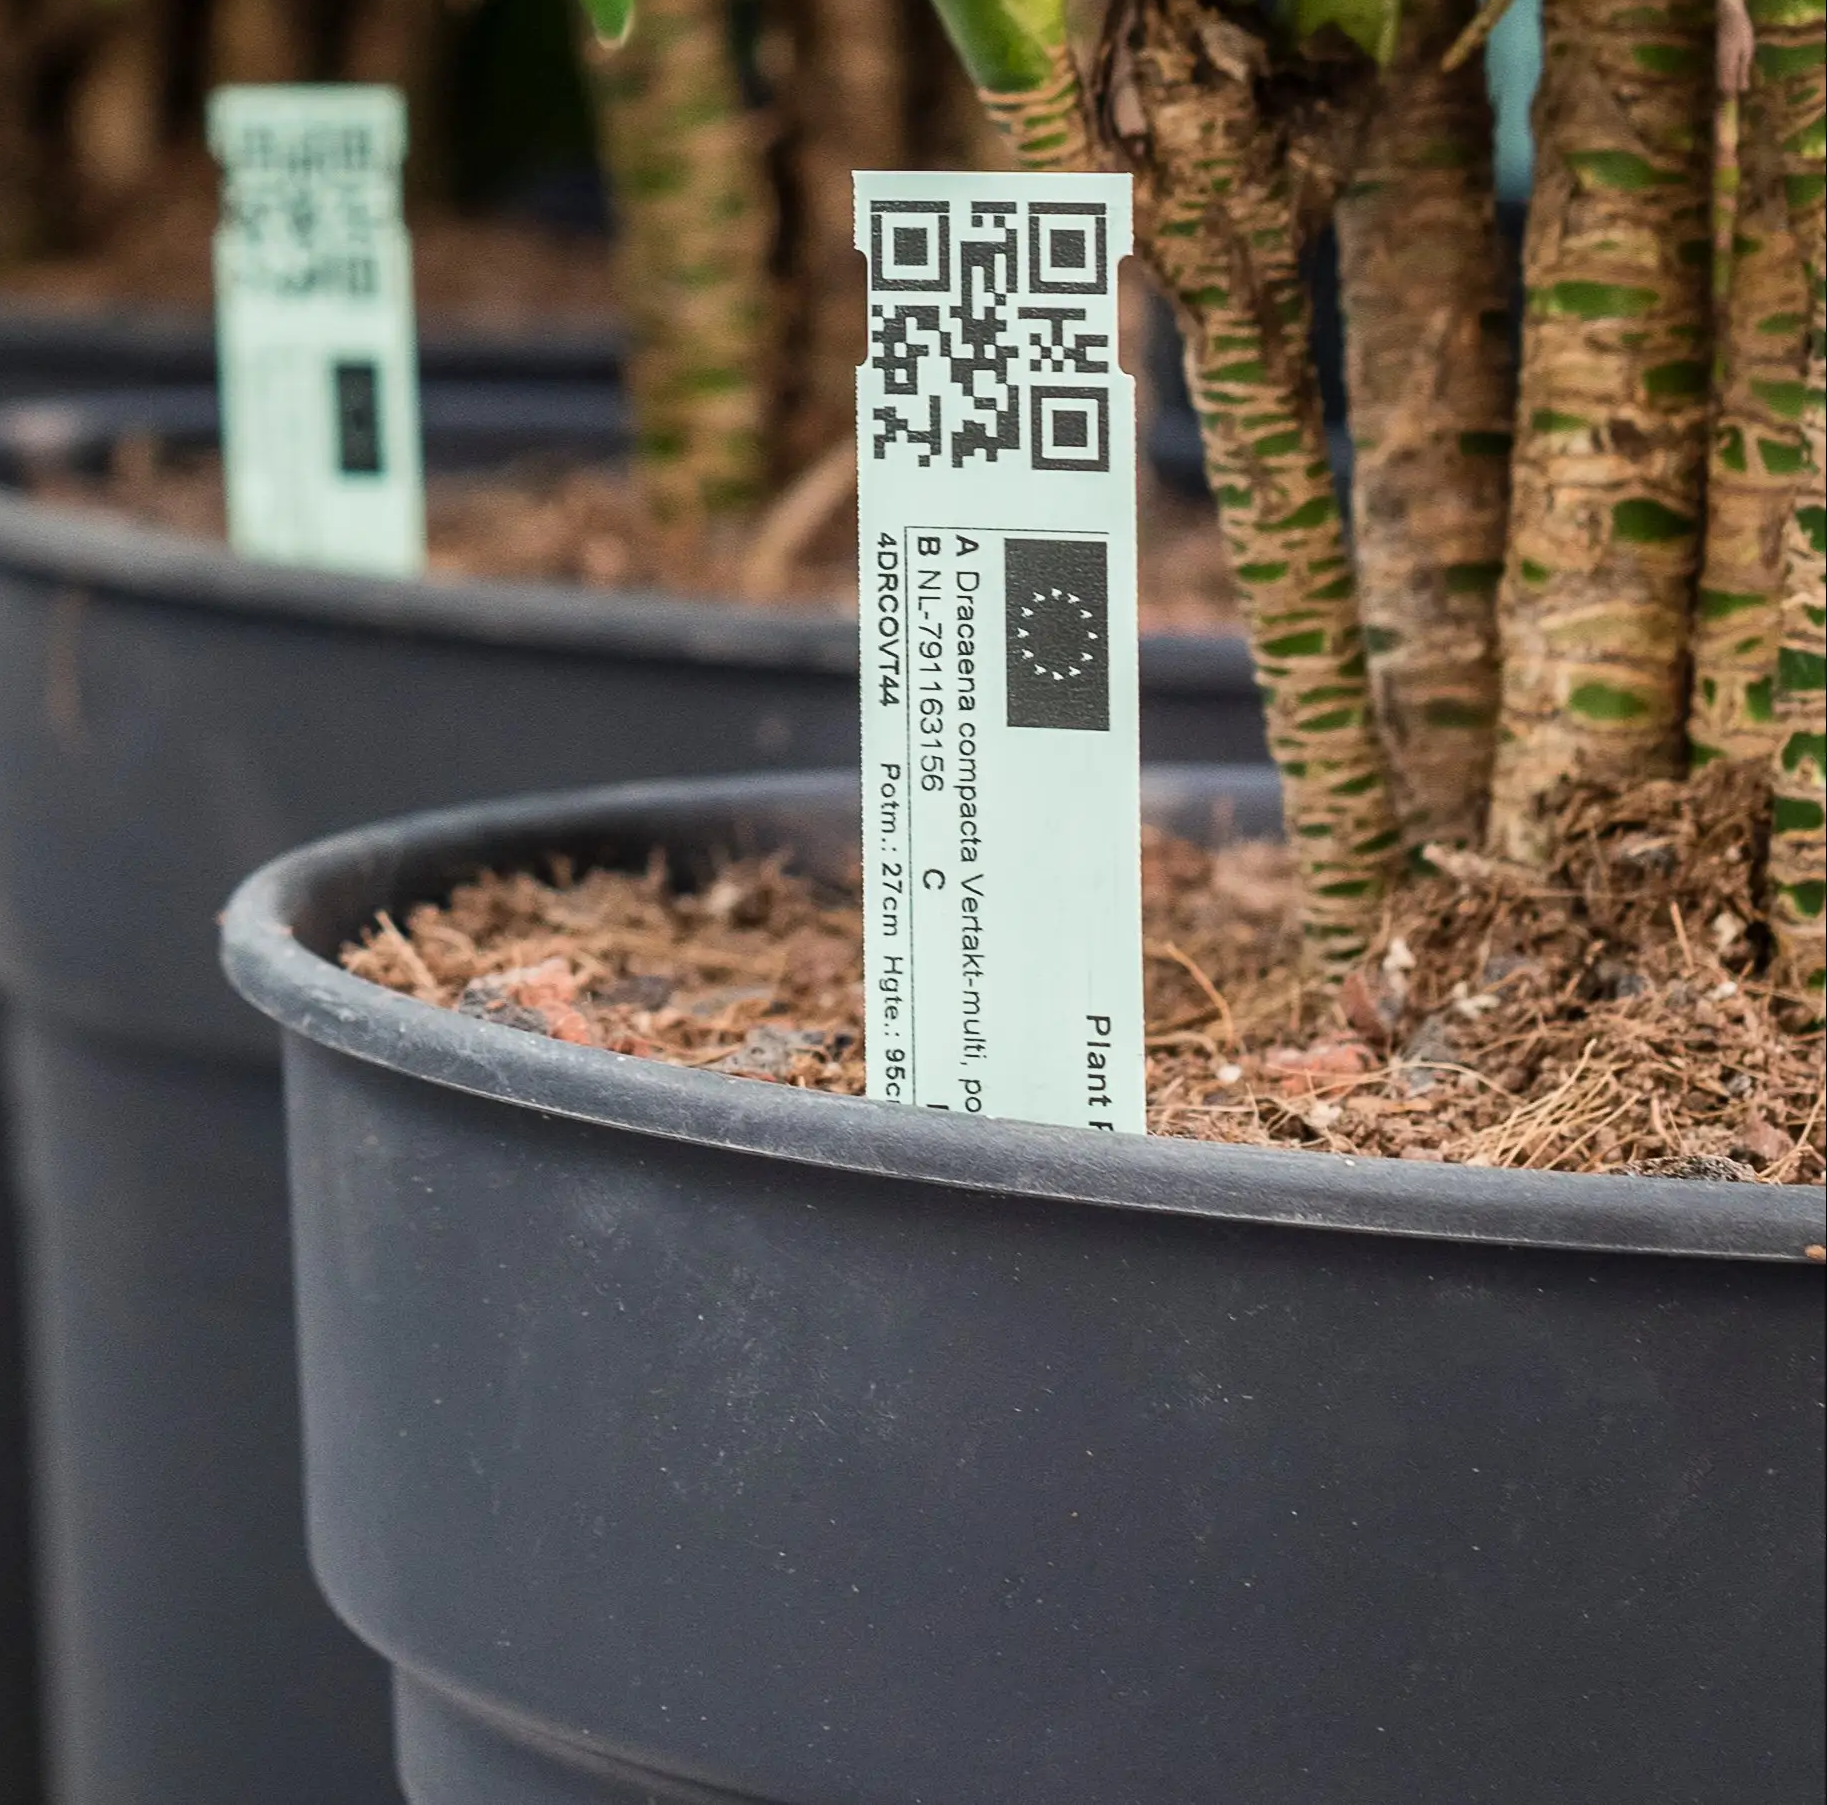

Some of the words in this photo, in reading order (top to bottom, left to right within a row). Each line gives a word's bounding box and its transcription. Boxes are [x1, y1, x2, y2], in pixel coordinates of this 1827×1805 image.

[917, 536, 942, 557] B
[955, 534, 980, 557] A
[877, 532, 900, 707] 4DRCOVT44
[956, 571, 980, 711] Dracaena
[917, 570, 944, 792] NL-791163156
[880, 763, 901, 852] Potm.:
[953, 722, 982, 862] compacta
[882, 862, 903, 937] 27cm
[922, 868, 946, 891] C
[879, 955, 904, 1037] Hgte.:
[959, 873, 987, 1066] Vertakt-multi,
[1086, 1014, 1113, 1107] Plant
